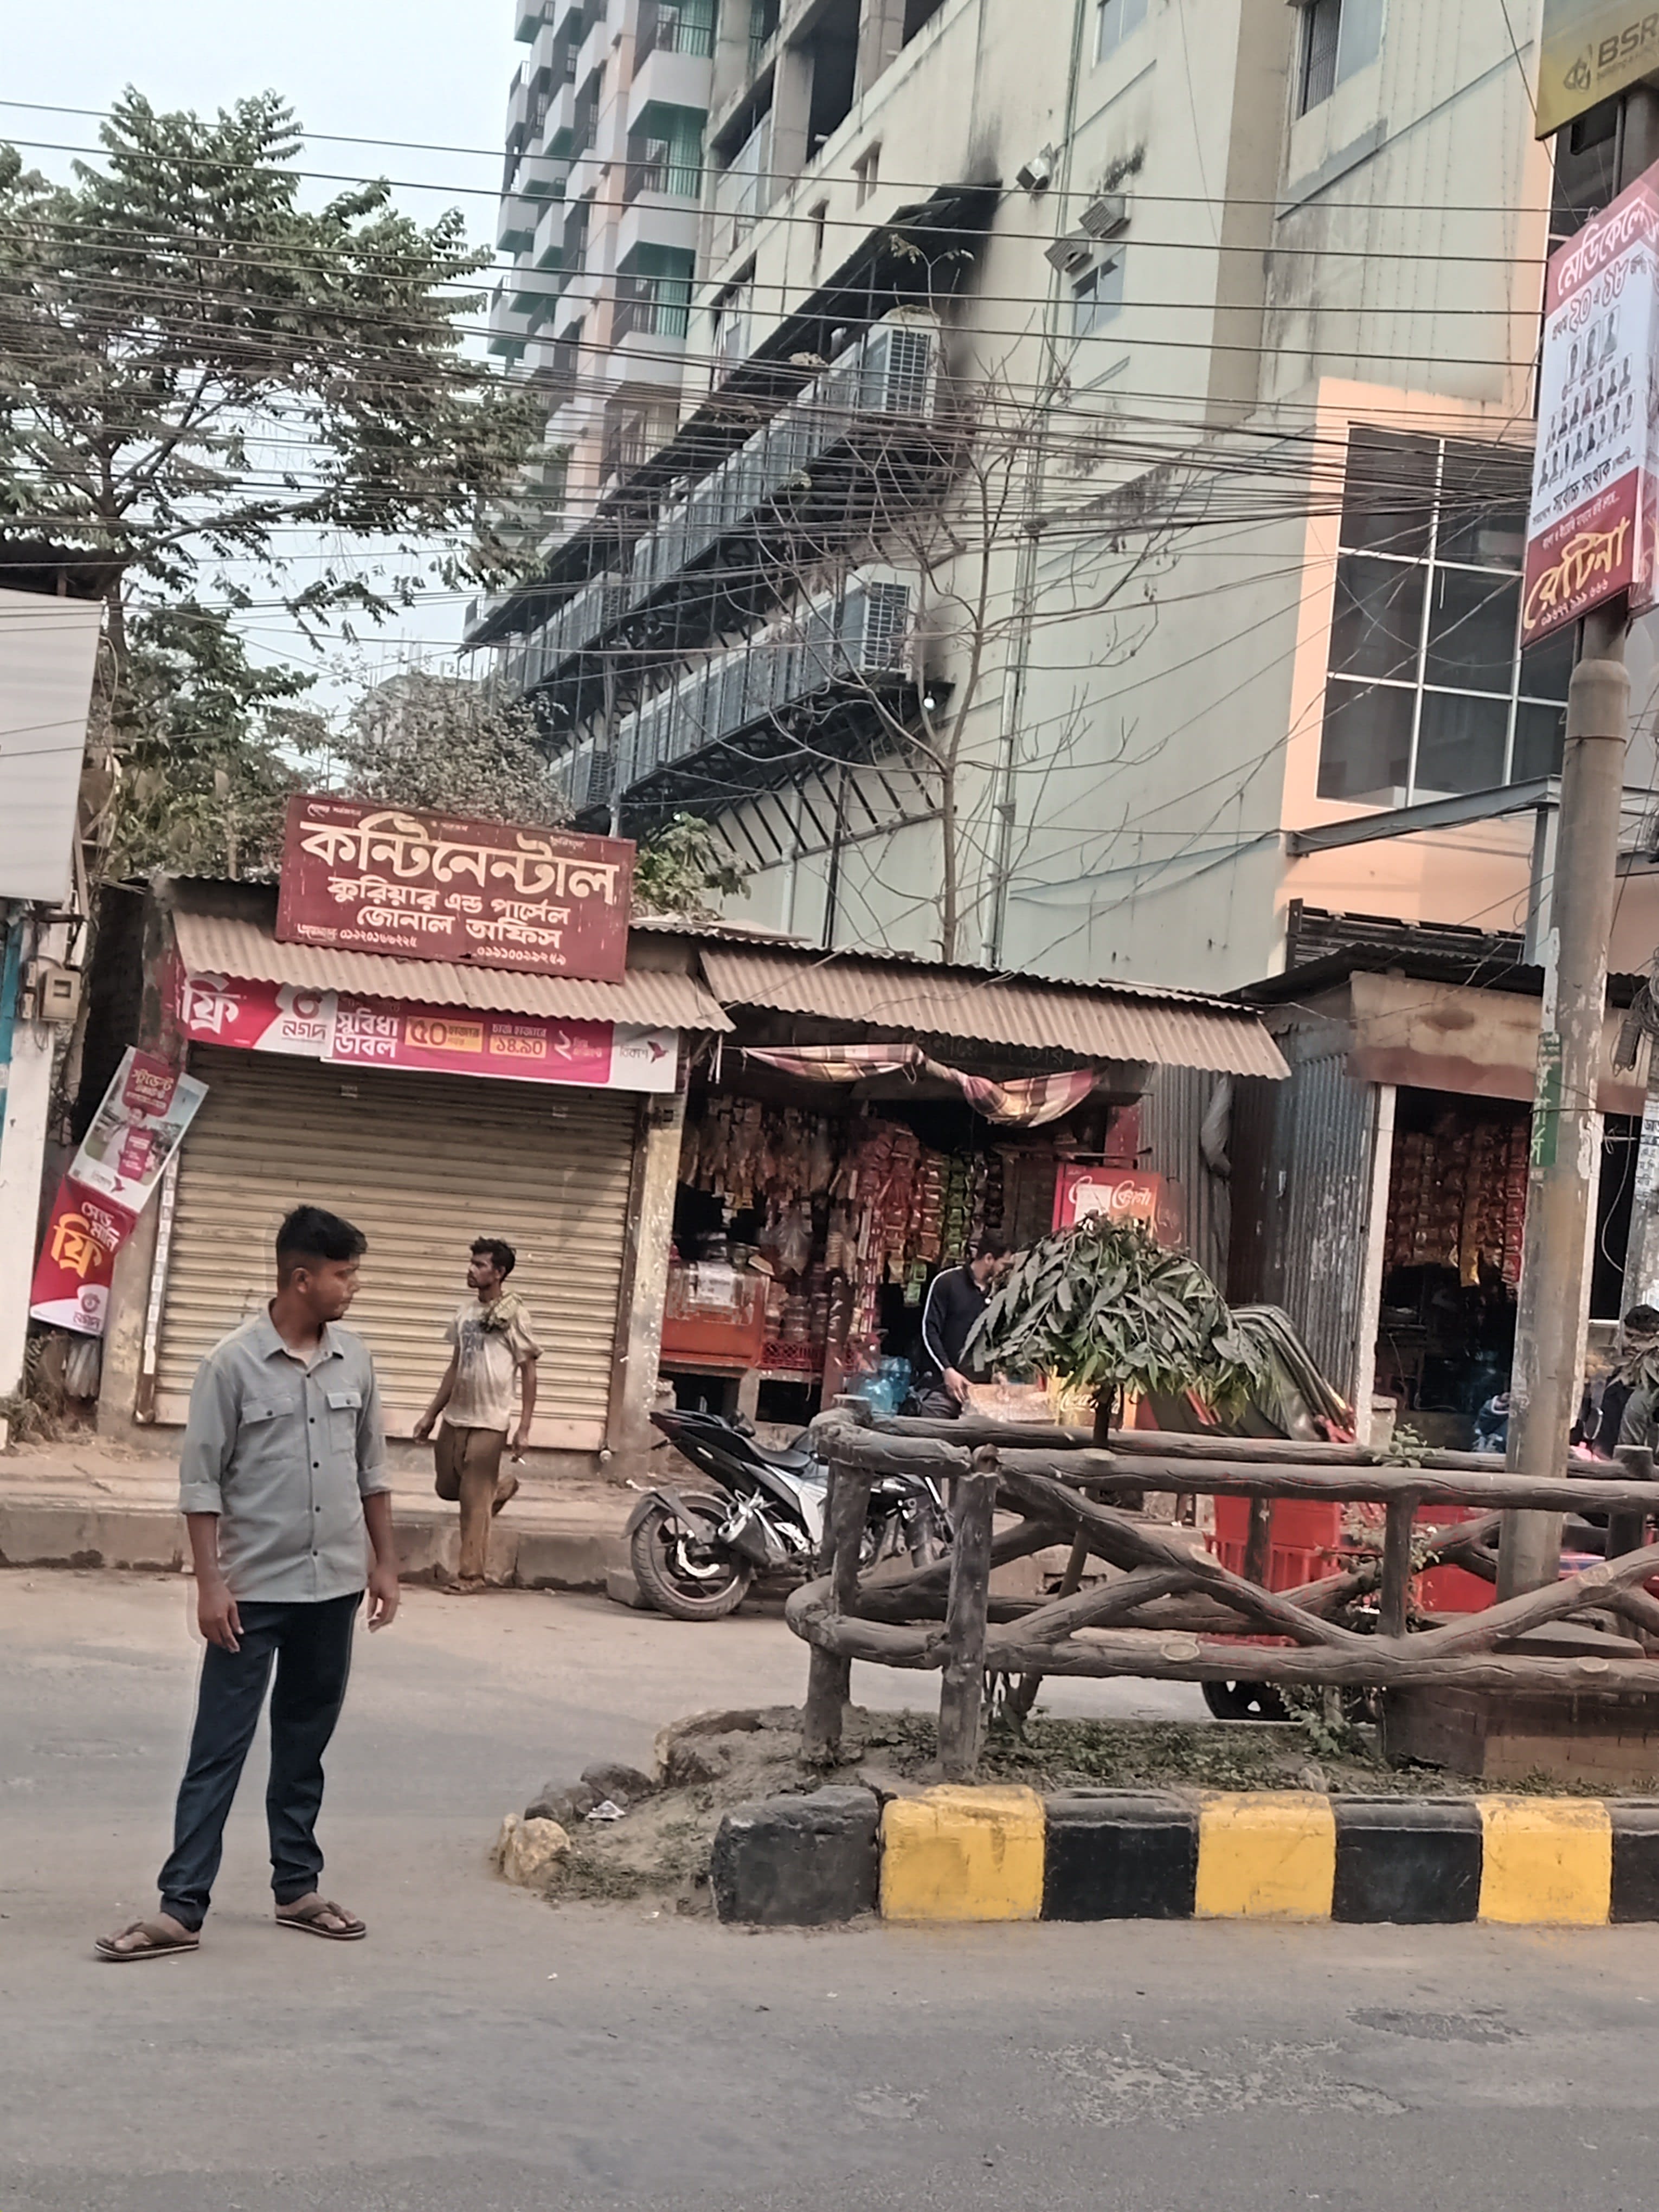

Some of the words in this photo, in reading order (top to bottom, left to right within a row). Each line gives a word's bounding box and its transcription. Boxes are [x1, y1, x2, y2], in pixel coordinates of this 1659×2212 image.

[1598, 12, 1659, 68] BSR
[1569, 287, 1592, 333] ২০
[1523, 516, 1631, 629] রেটিনা
[300, 811, 619, 904] কন্টিনেন্টাল
[327, 874, 440, 908] কুরিয়ার
[445, 893, 482, 914] এন্ড
[491, 898, 570, 925] পার্সেল
[357, 905, 455, 934] জোনাল
[466, 918, 563, 949] অফিস
[282, 1020, 327, 1040] নগদ
[337, 1007, 400, 1037] সুবিধা
[410, 1019, 447, 1046] ৫০
[335, 1032, 398, 1058] ডাবল
[496, 1037, 543, 1056] ১৪.৯০
